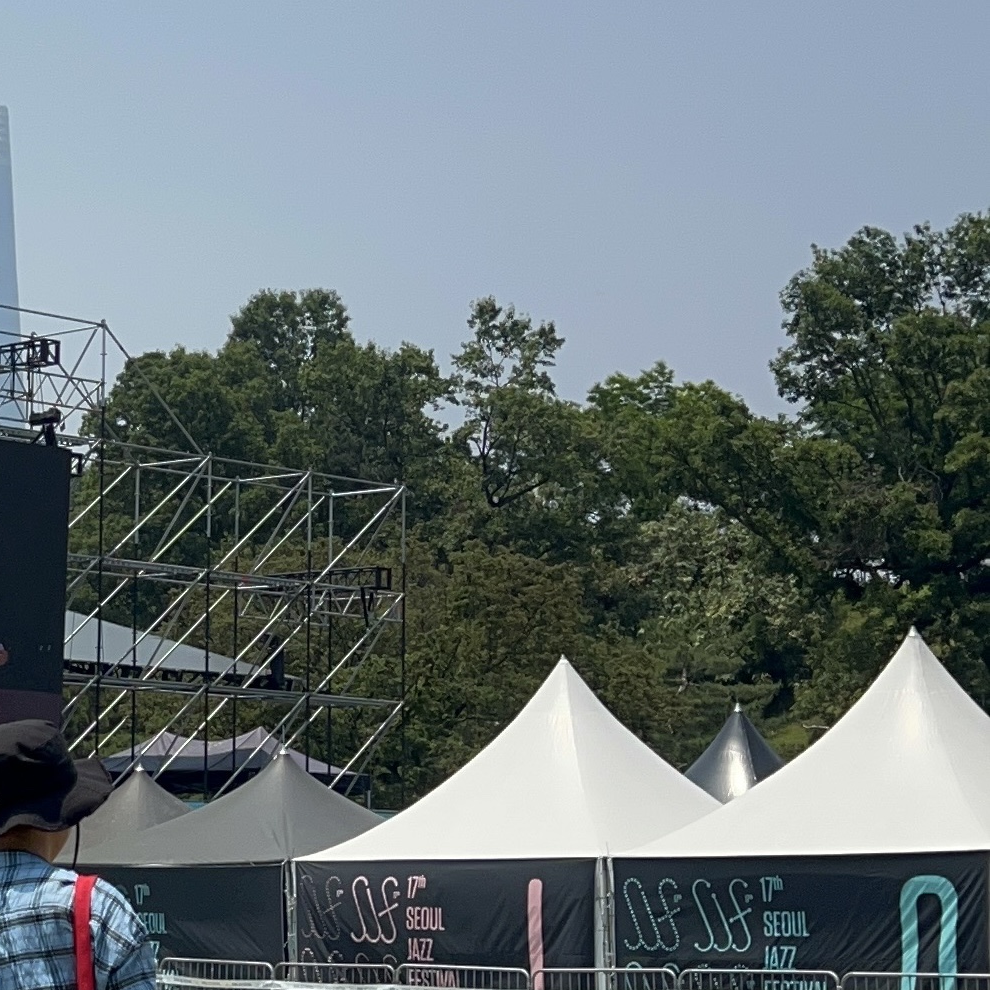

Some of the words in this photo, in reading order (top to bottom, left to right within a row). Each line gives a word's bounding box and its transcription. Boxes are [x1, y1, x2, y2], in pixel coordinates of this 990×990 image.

[760, 876, 783, 903] 17th
[406, 906, 445, 931] SEOUL
[763, 911, 810, 937] SEOUL
[407, 937, 434, 961] JAZZ
[763, 946, 797, 971] JAZZ
